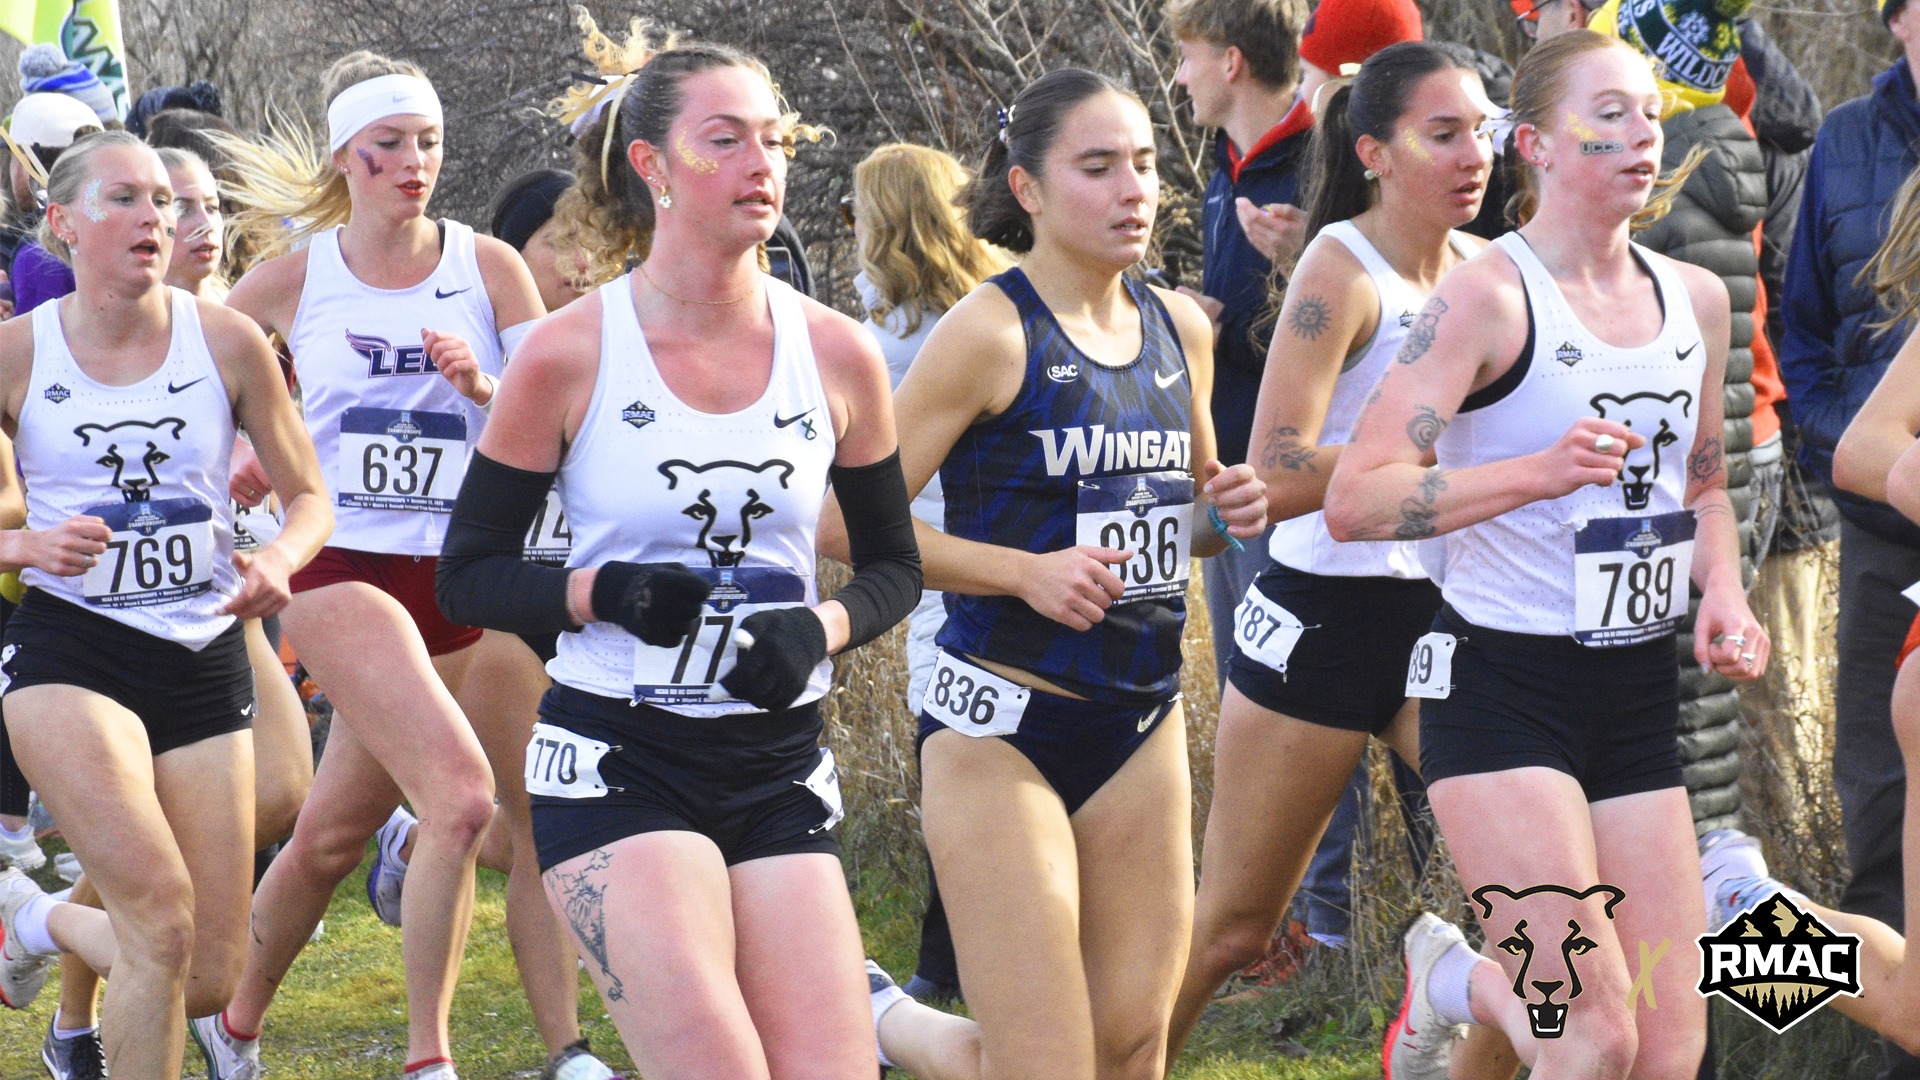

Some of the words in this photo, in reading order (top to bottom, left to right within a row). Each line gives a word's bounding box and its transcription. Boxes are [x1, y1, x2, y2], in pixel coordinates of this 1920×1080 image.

[45, 390, 70, 398] RMAC
[1051, 364, 1079, 378] SAC
[362, 442, 443, 496] 637
[1028, 424, 1191, 476] WINGAT
[106, 533, 193, 593] 769
[1100, 516, 1179, 584] 836
[1599, 556, 1675, 627] 789
[1238, 595, 1282, 650] 787
[1409, 643, 1433, 684] 89
[935, 666, 1000, 725] 836
[533, 737, 578, 785] 770
